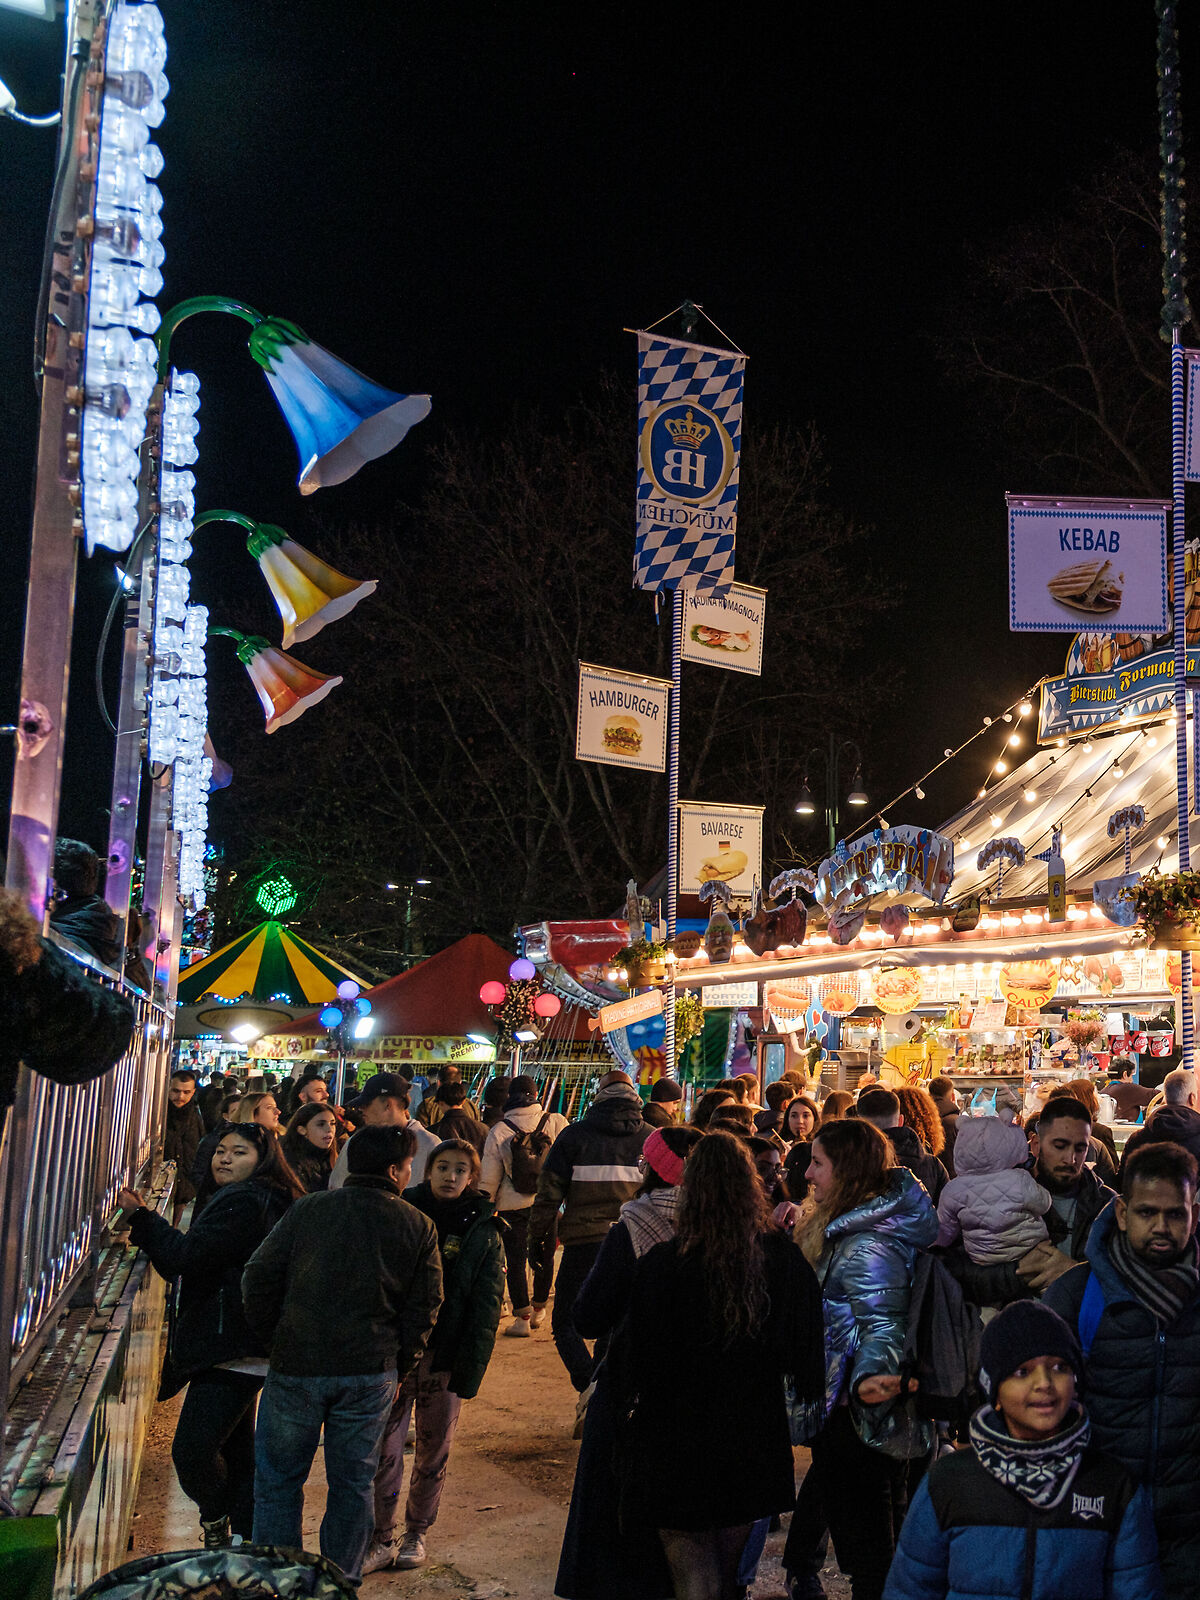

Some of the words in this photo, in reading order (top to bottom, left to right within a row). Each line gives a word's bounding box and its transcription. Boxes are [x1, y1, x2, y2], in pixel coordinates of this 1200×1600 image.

[1058, 528, 1121, 553] KEBAB
[589, 690, 660, 720] HAMBURGER
[700, 822, 744, 839] BAVARESE
[1006, 992, 1050, 1008] CALDI
[382, 1038, 434, 1051] TUTTO
[450, 1043, 482, 1061] PREMIO
[1072, 1492, 1105, 1516] EVERLAST
